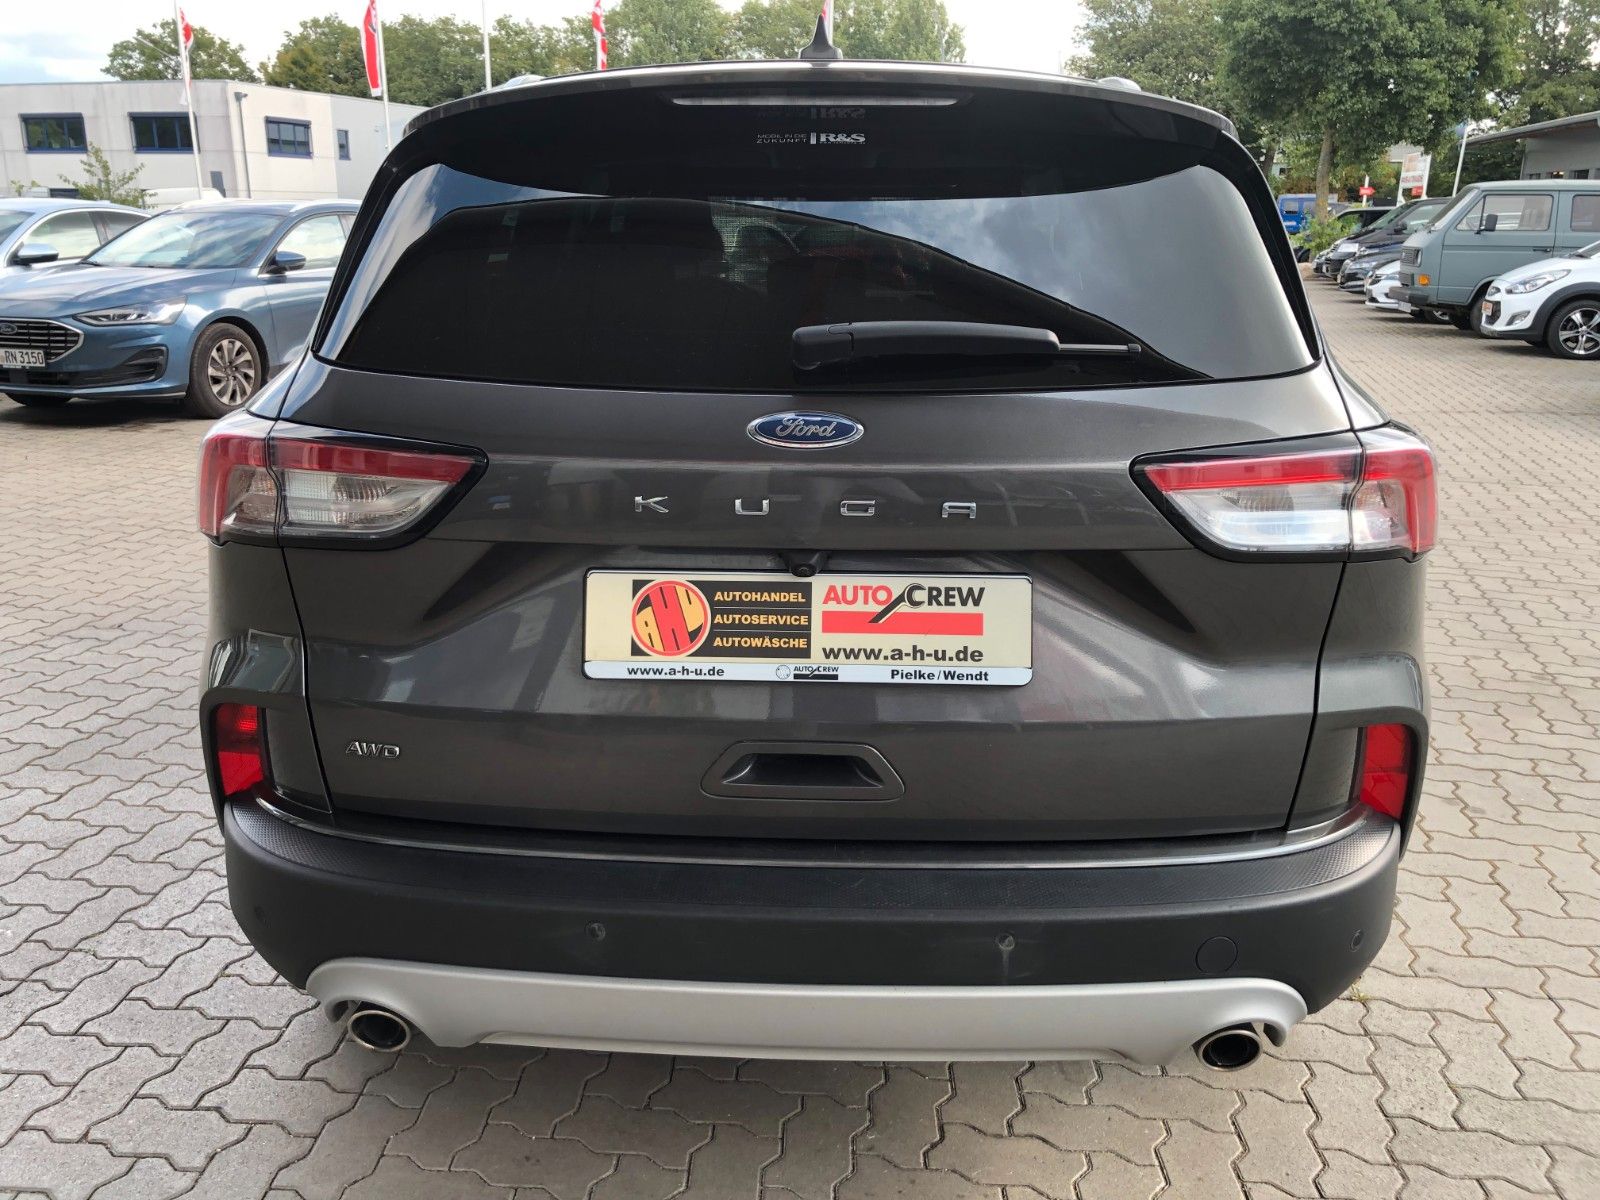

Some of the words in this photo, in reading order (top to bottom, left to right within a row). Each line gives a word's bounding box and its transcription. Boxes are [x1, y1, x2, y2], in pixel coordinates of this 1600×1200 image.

[819, 132, 866, 142] R&S
[4, 350, 18, 364] RN
[18, 351, 44, 365] 3150
[775, 416, 837, 438] Ford
[713, 591, 806, 603] AUTOHANDEL
[822, 584, 893, 607] AUTO
[906, 582, 986, 608] CREW
[713, 614, 809, 625] AUTOSERVICE
[713, 636, 808, 649] AUTOWÄSCHE
[822, 644, 984, 662] www.a-h-u.de
[627, 665, 725, 677] www.a-h-u.de
[793, 665, 814, 673] AUTO
[817, 665, 840, 673] CREW
[345, 740, 400, 759] AWD
